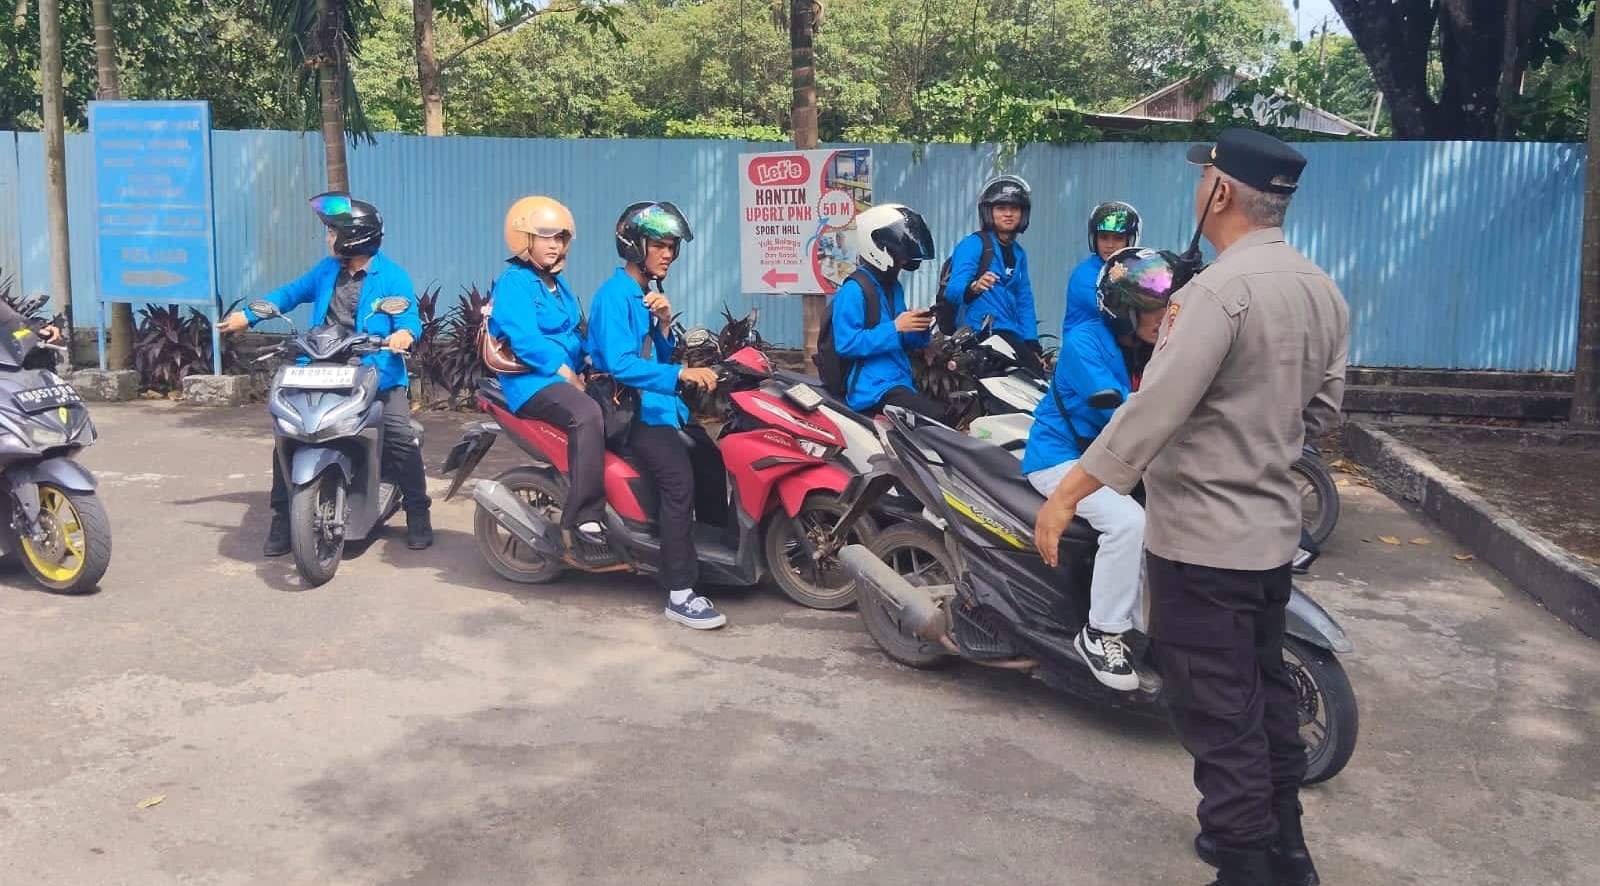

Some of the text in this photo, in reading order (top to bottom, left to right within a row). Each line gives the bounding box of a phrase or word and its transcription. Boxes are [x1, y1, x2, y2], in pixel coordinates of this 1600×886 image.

[757, 159, 802, 184] Let's
[755, 188, 807, 205] KANTIN
[746, 206, 812, 222] UPGRI PNK
[823, 202, 850, 216] 50 M
[755, 225, 801, 236] SPORT HALL
